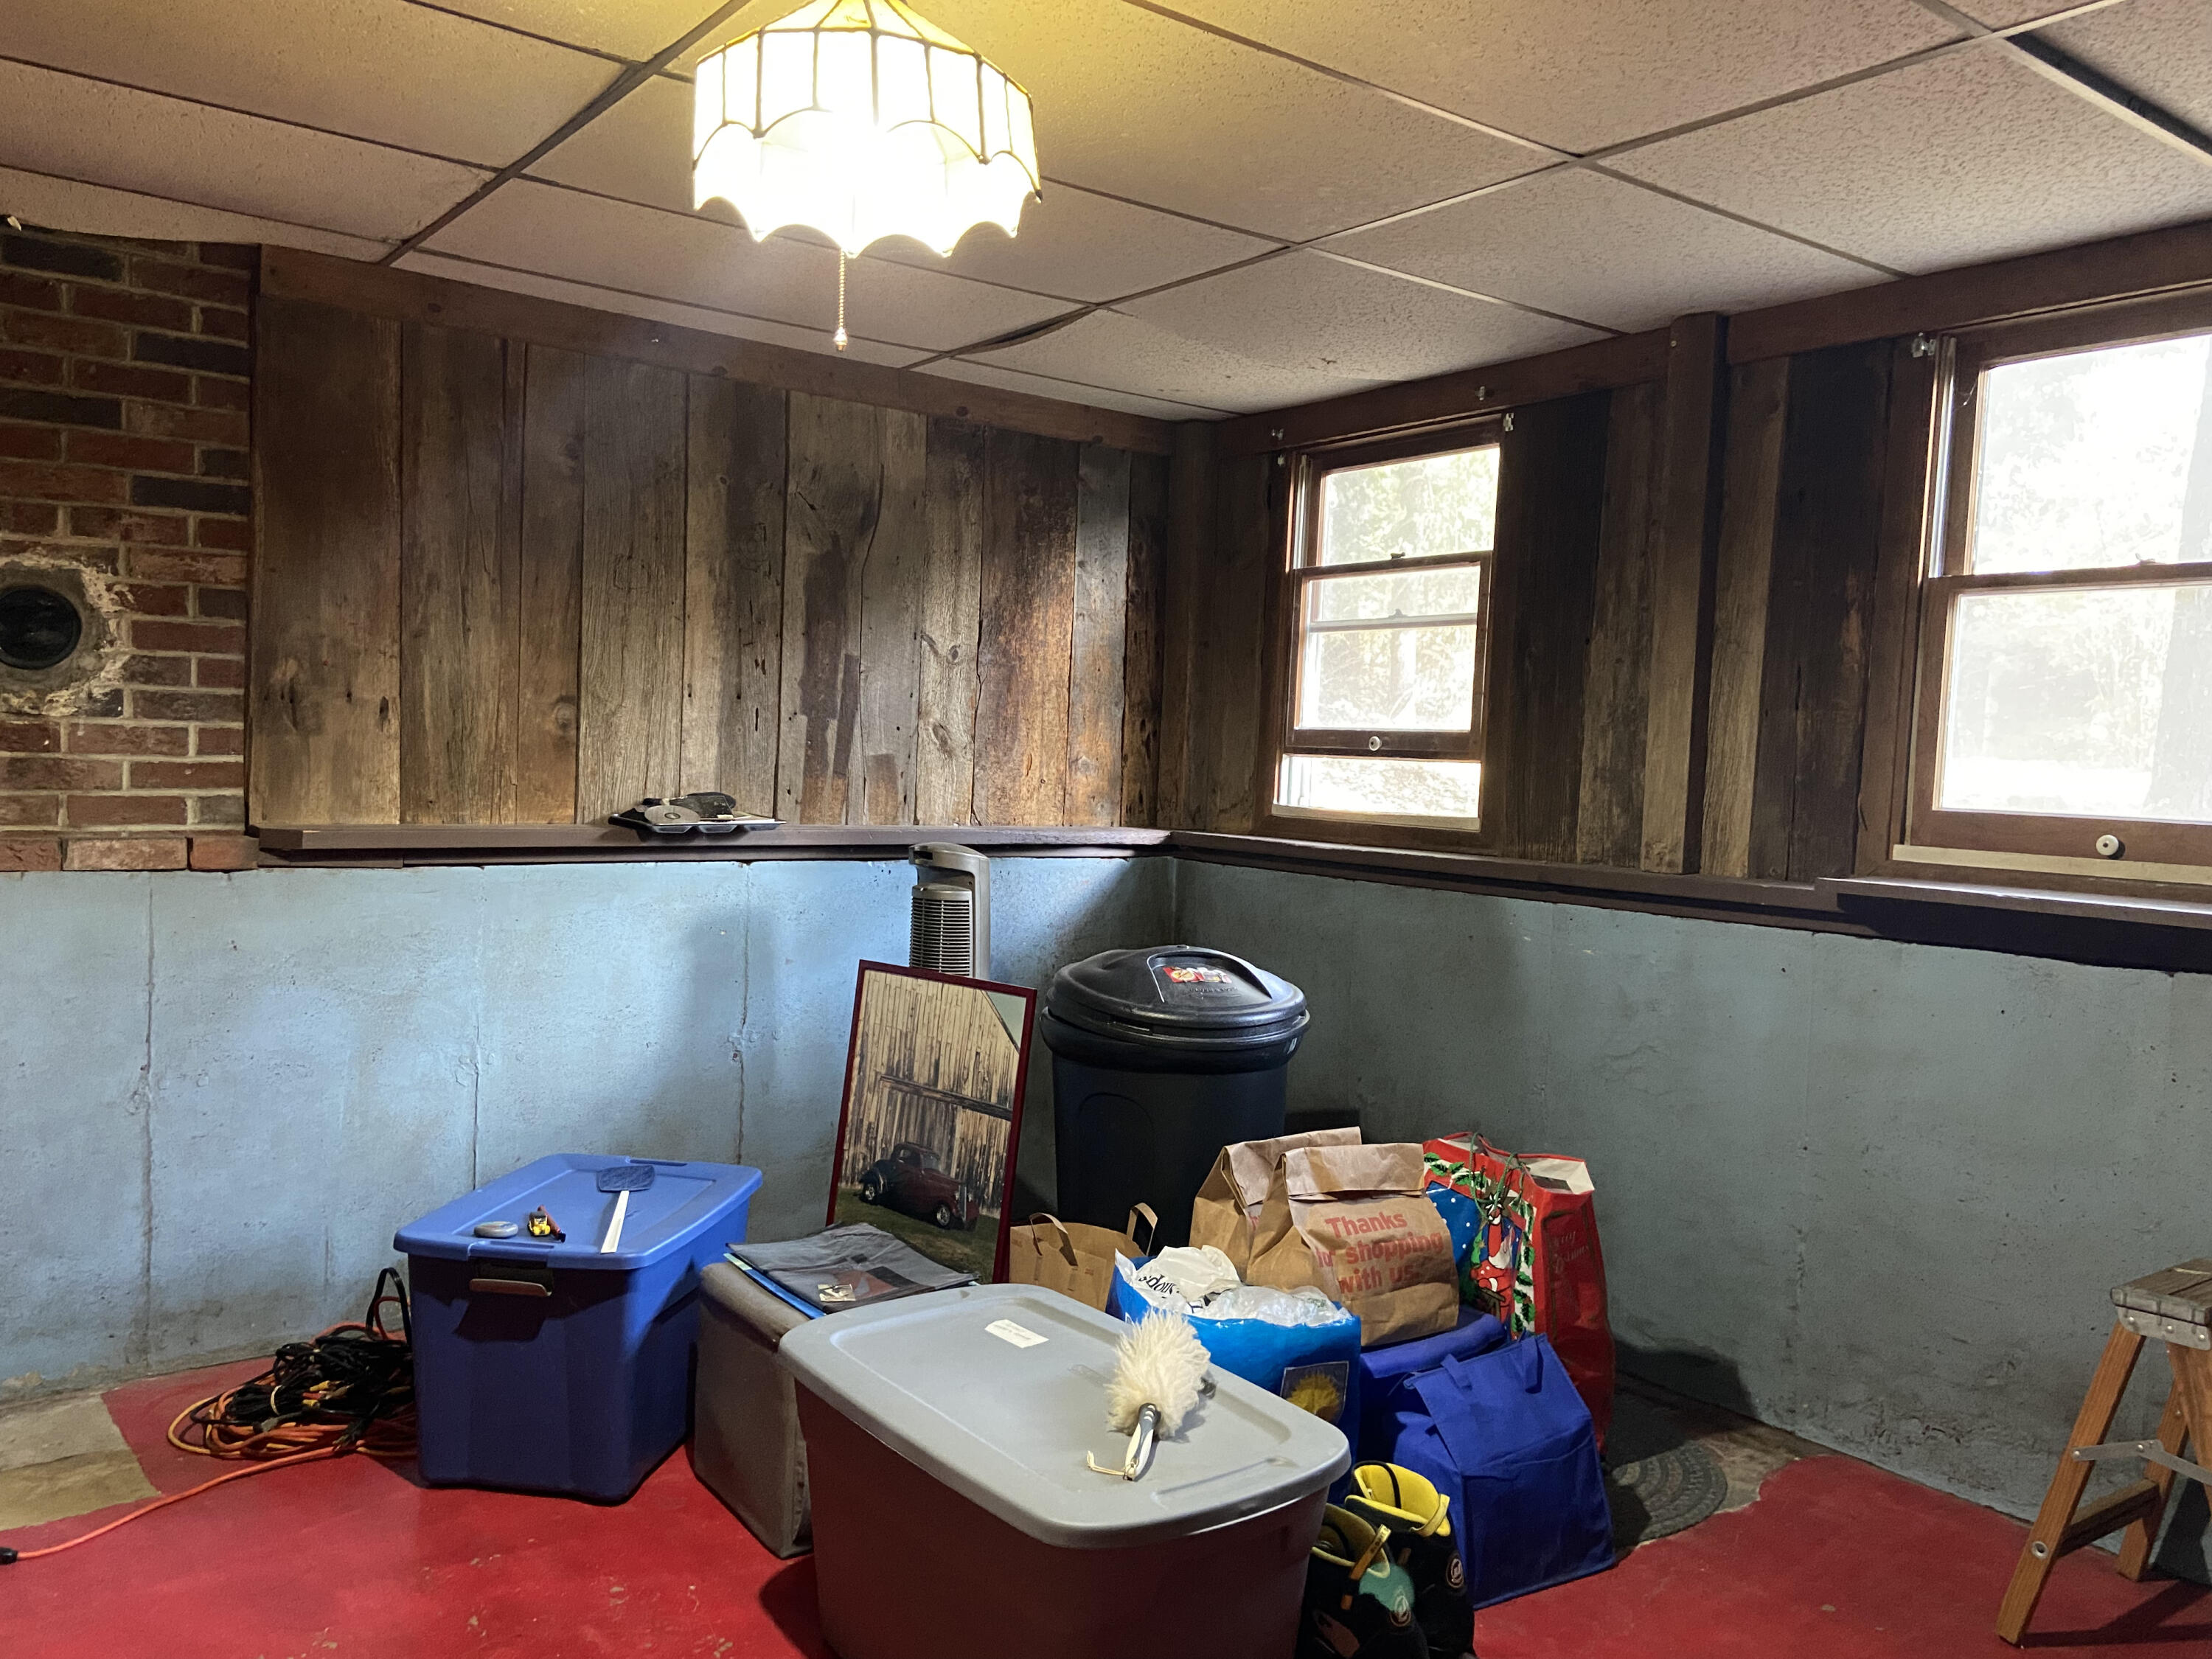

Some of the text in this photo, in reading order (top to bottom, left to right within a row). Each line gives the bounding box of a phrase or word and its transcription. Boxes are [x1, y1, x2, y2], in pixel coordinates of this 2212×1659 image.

[1325, 1211, 1408, 1239] Thanks
[1346, 1232, 1444, 1263] shopping
[1338, 1265, 1383, 1294] with
